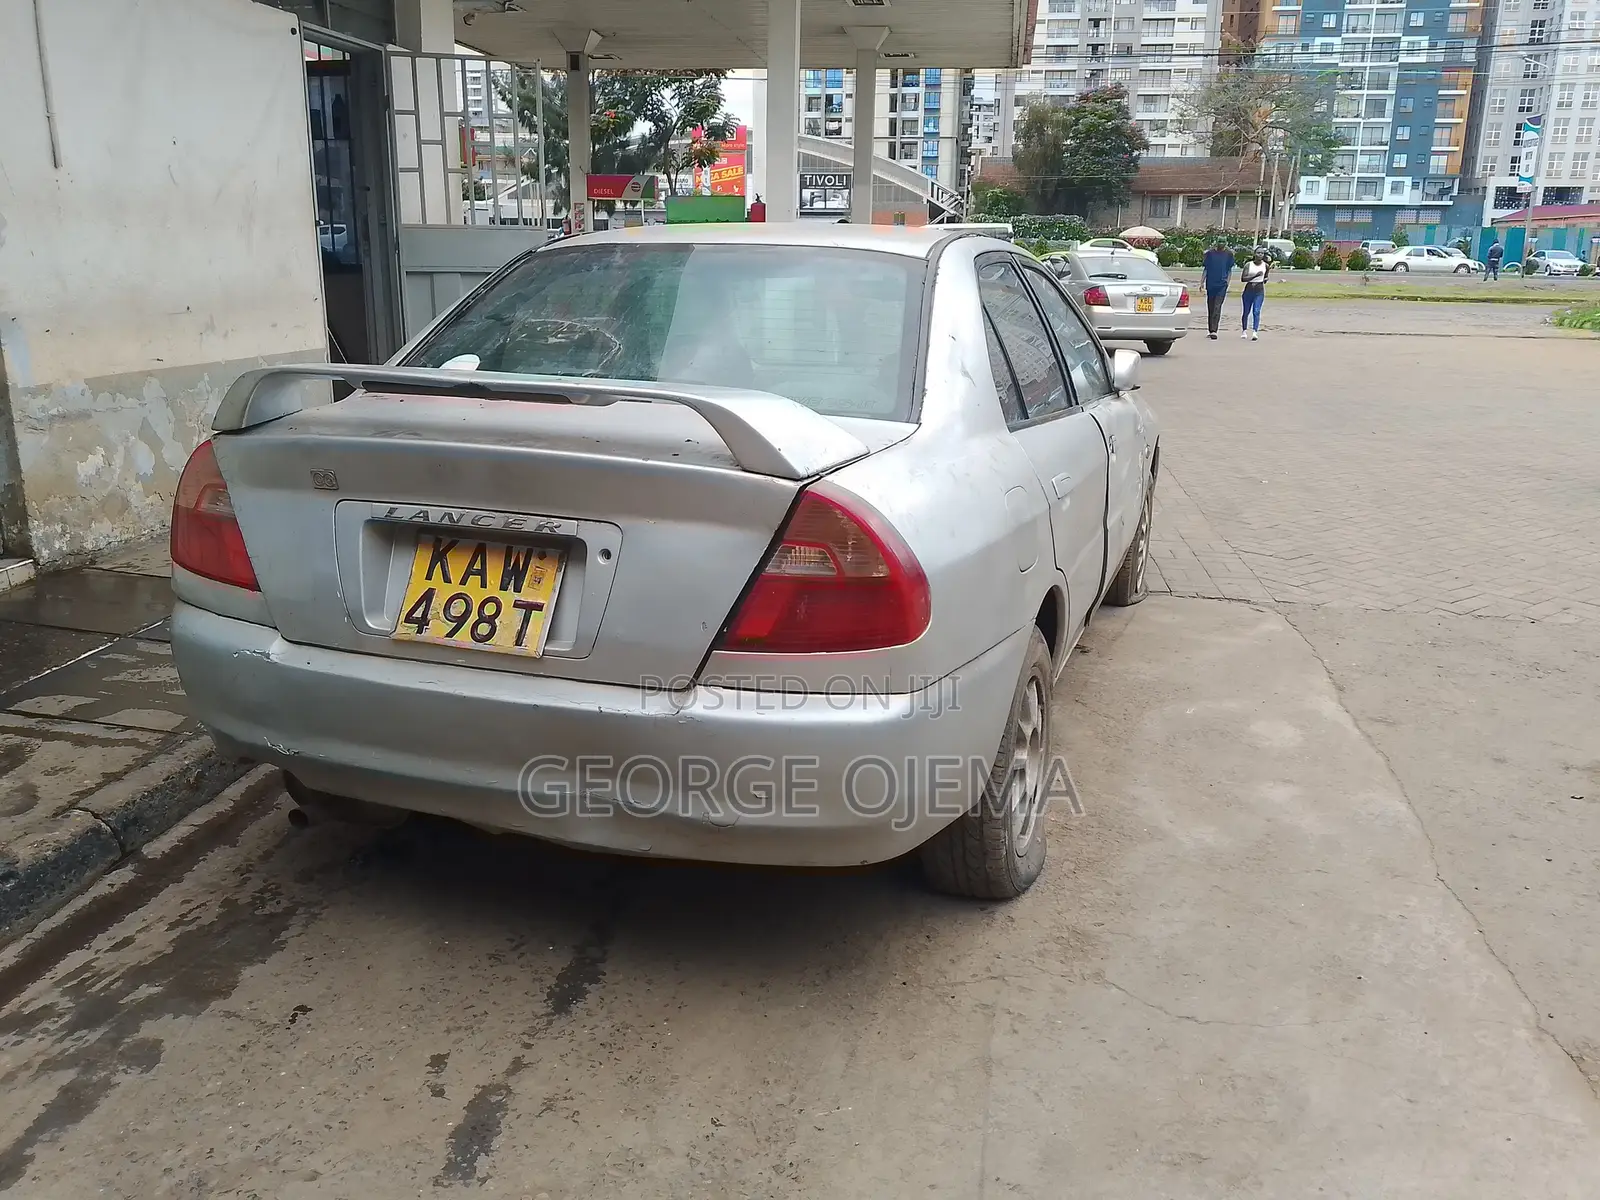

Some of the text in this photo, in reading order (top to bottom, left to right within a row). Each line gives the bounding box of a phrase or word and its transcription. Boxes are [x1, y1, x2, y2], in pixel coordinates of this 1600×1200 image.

[721, 166, 744, 178] SALE
[804, 175, 847, 186] TIVOLI
[383, 507, 562, 534] LANCER
[425, 536, 534, 593] KAW
[403, 587, 545, 647] 498T
